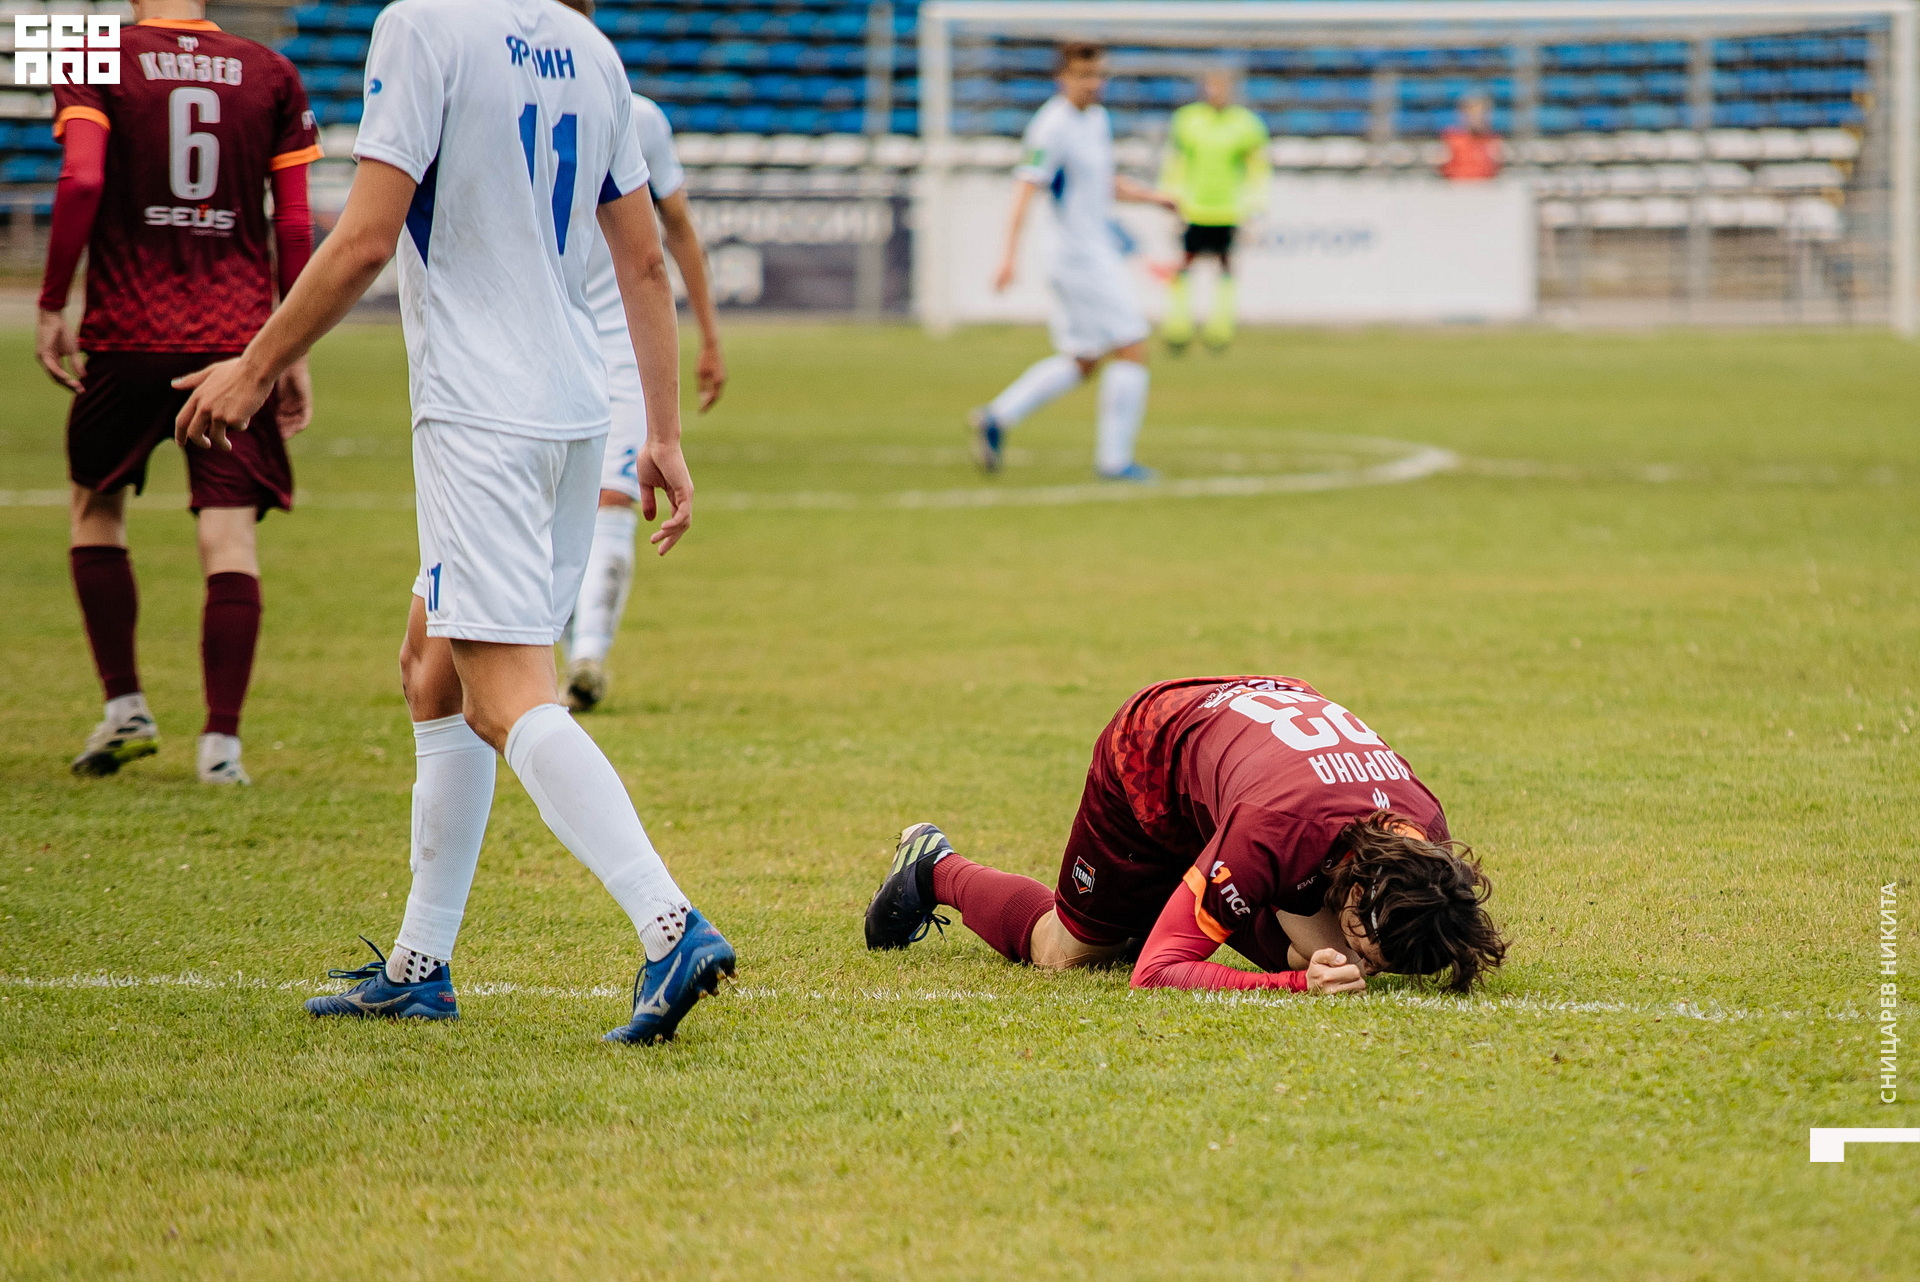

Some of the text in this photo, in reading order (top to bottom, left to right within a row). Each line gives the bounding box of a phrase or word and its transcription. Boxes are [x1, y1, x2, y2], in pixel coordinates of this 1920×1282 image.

[138, 52, 242, 86] КНЯЗЕВ
[506, 36, 576, 79] ЯРИН
[168, 86, 221, 200] 6
[518, 103, 577, 256] 11
[144, 205, 237, 230] SEUS
